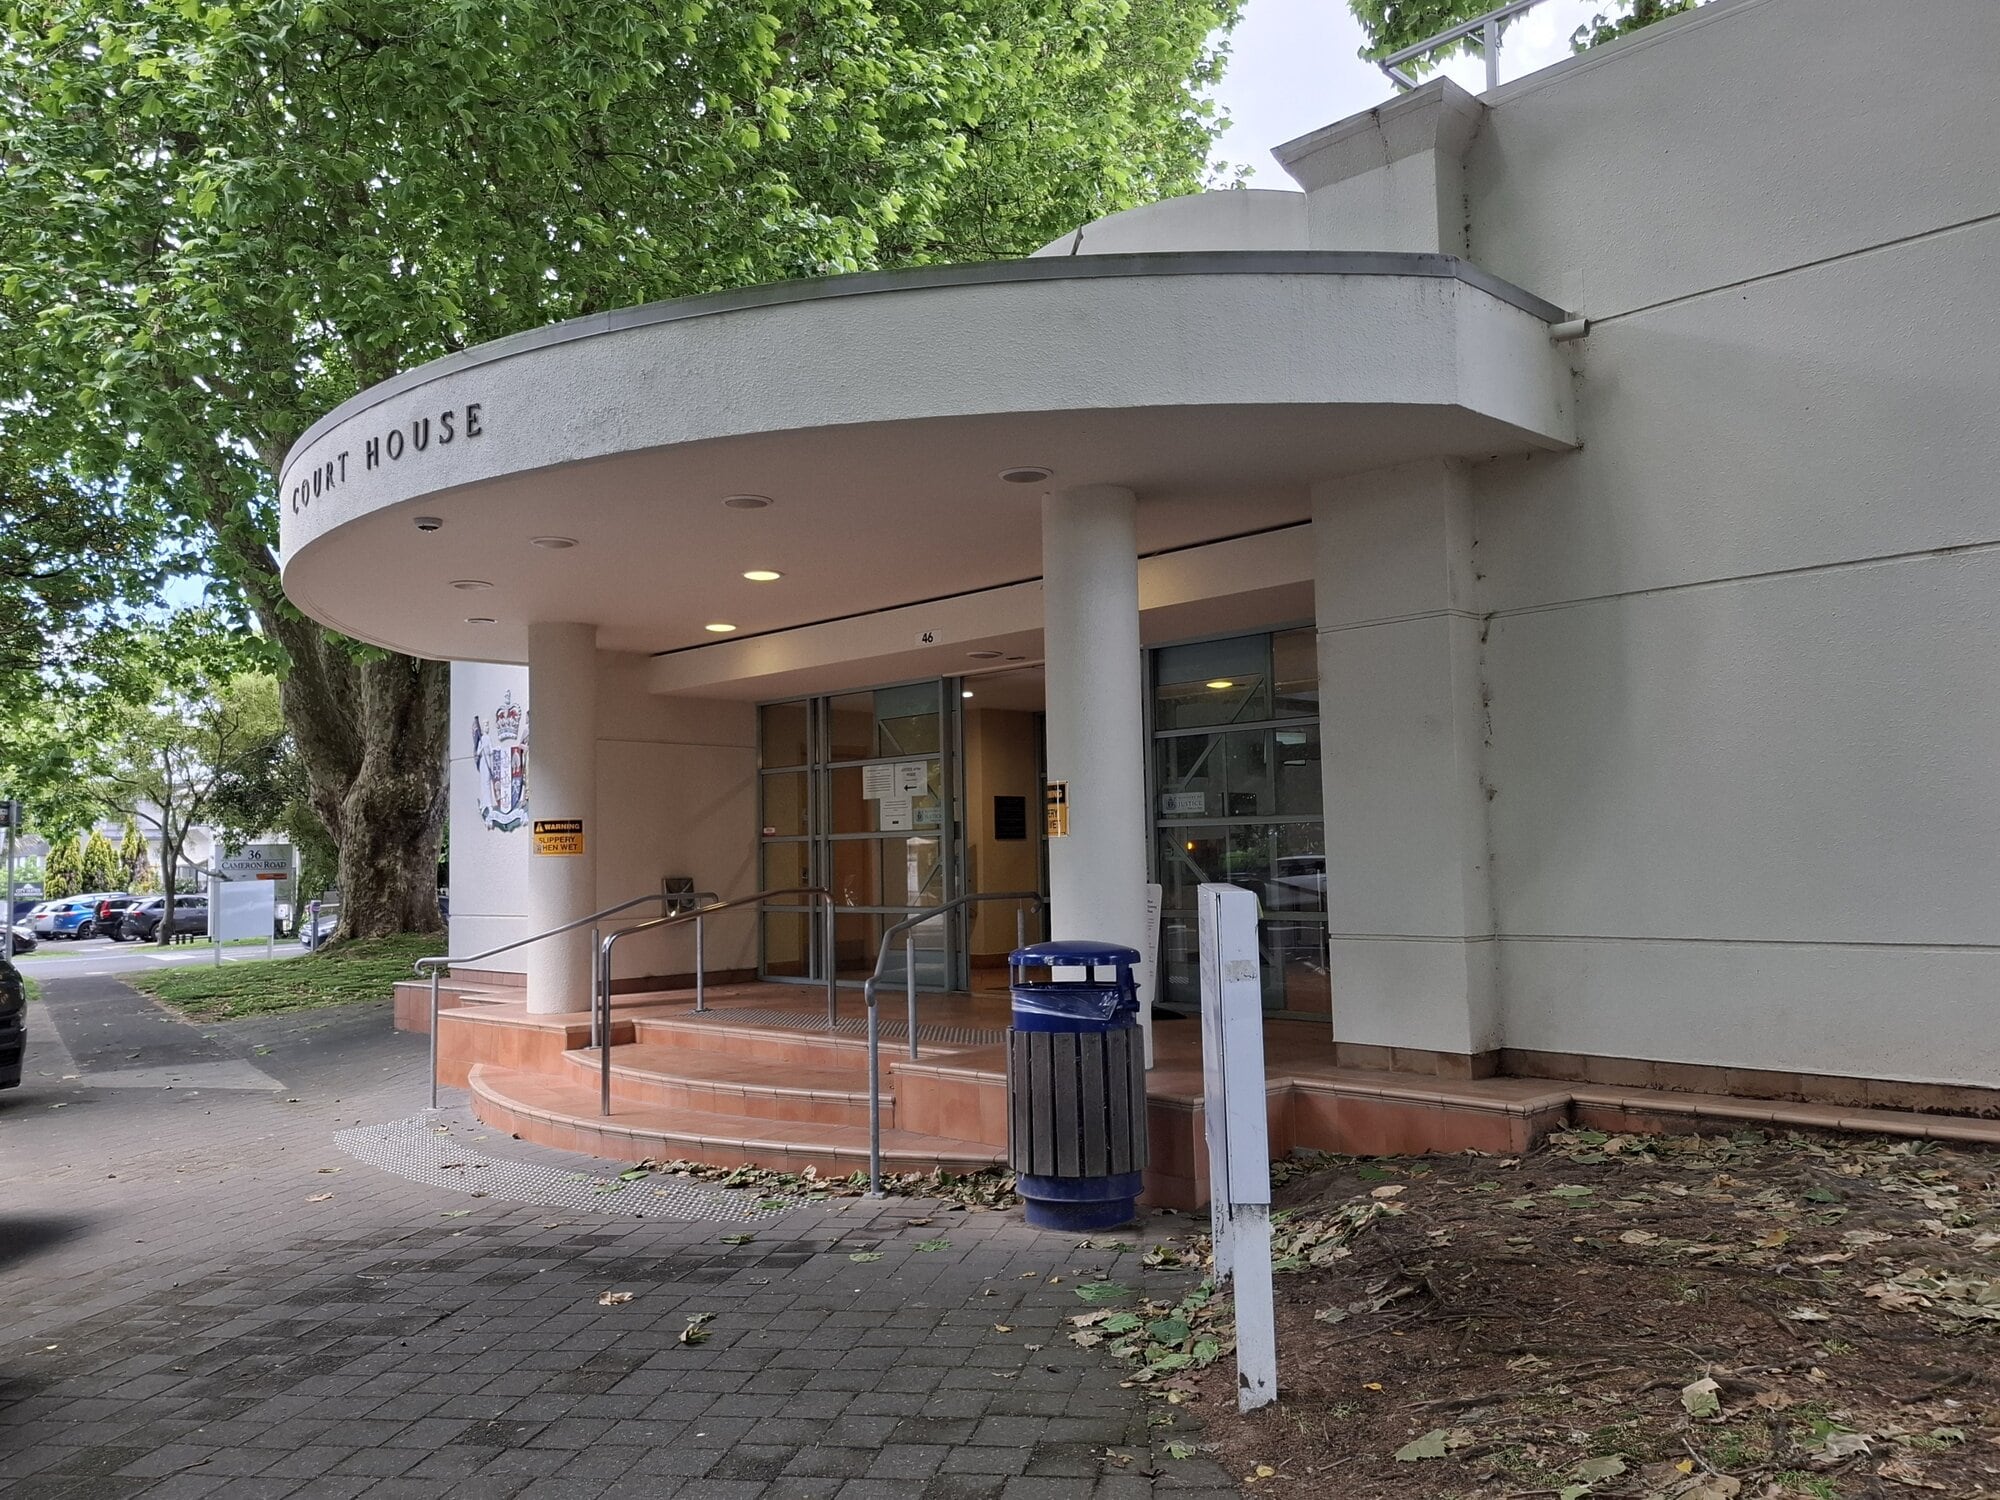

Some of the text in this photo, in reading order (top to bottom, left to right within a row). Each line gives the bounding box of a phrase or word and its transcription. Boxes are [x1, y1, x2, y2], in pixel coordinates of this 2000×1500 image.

[292, 402, 483, 516] COURT HOUSE
[921, 631, 934, 644] 46
[543, 823, 580, 831] WARNING
[560, 843, 578, 851] WET
[247, 849, 262, 860] 36
[221, 861, 287, 870] CAMERON ROAD
